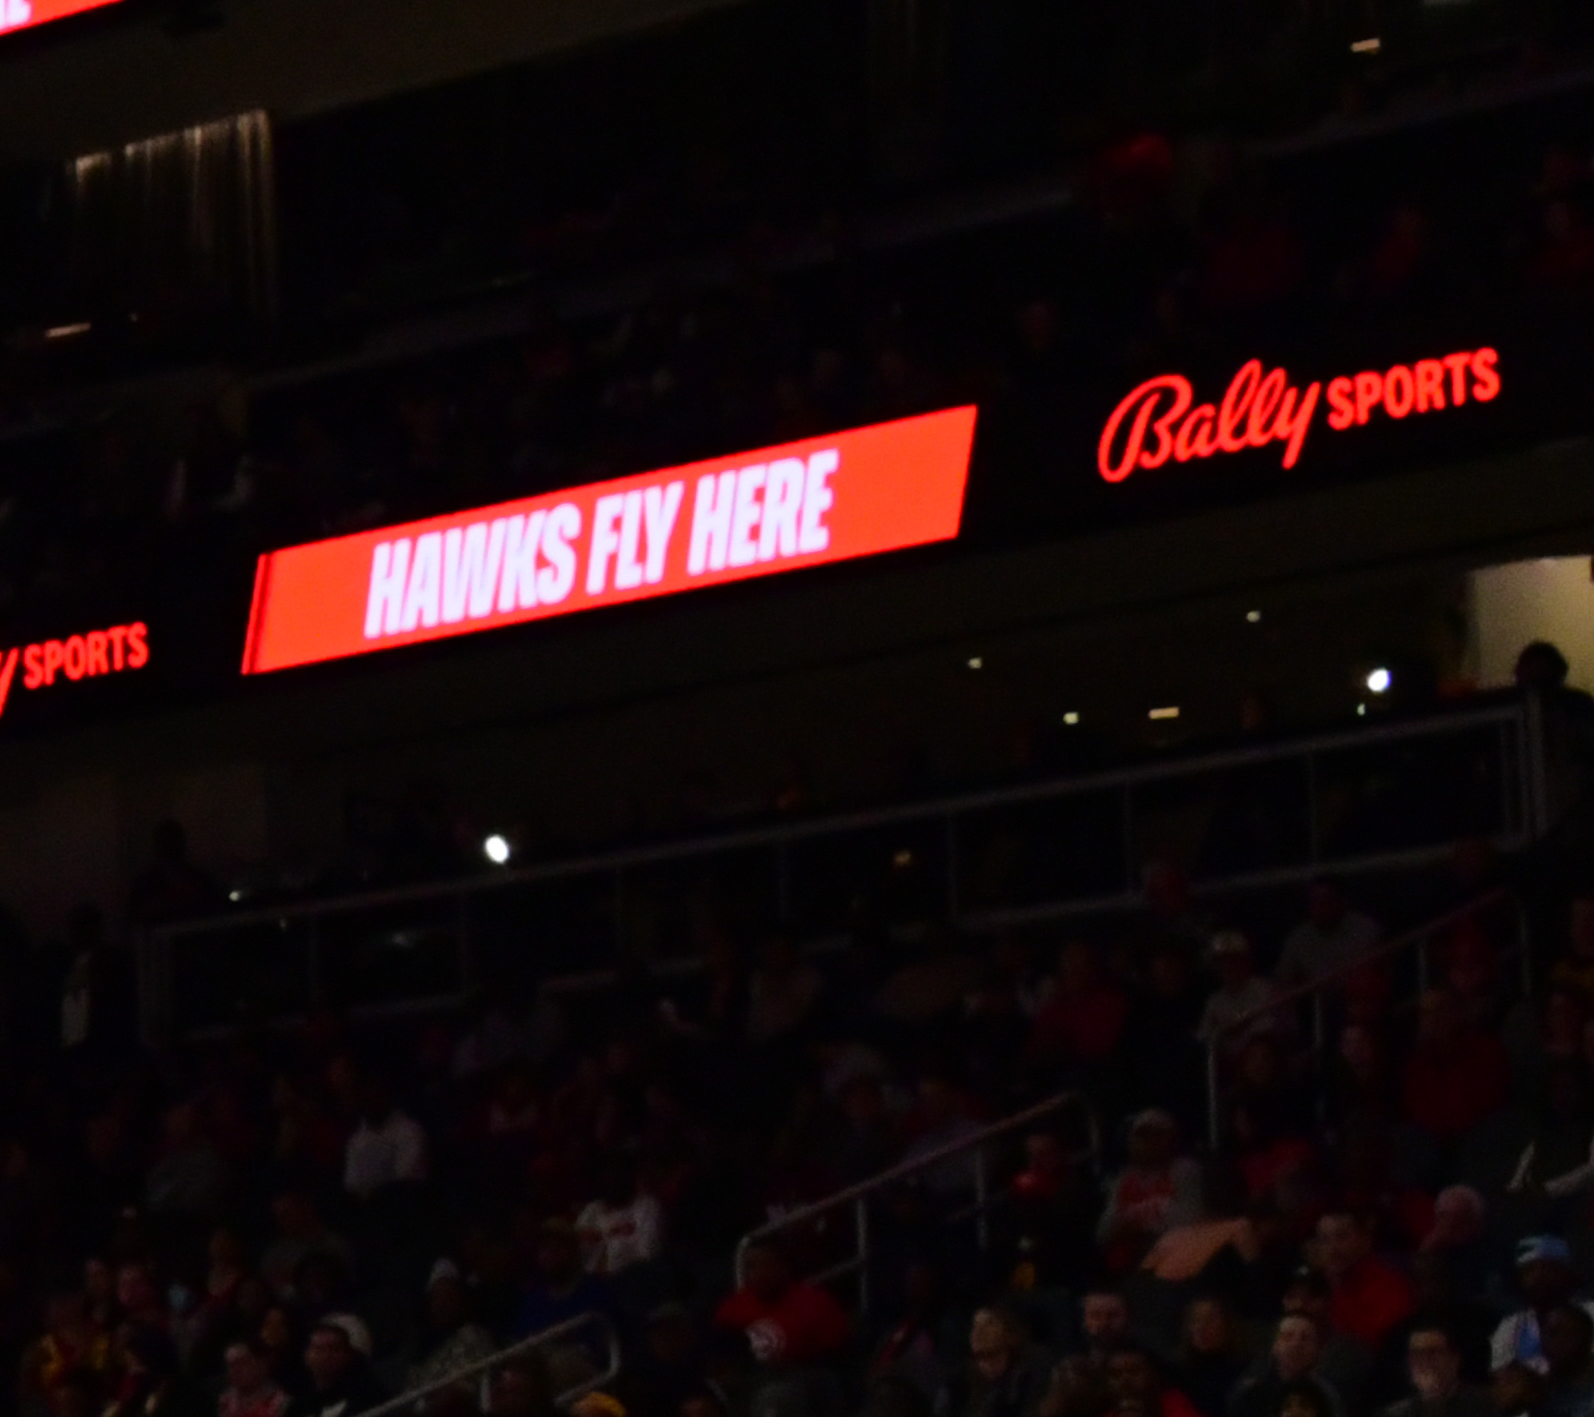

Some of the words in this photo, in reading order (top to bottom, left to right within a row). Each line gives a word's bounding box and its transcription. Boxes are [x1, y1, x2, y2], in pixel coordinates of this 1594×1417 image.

[1098, 360, 1322, 484] Bally
[1326, 348, 1503, 430] SPORTS
[362, 505, 581, 640] HAWKS
[583, 478, 687, 601] FLY
[685, 449, 841, 575] HERE
[22, 621, 148, 691] SPORTS
